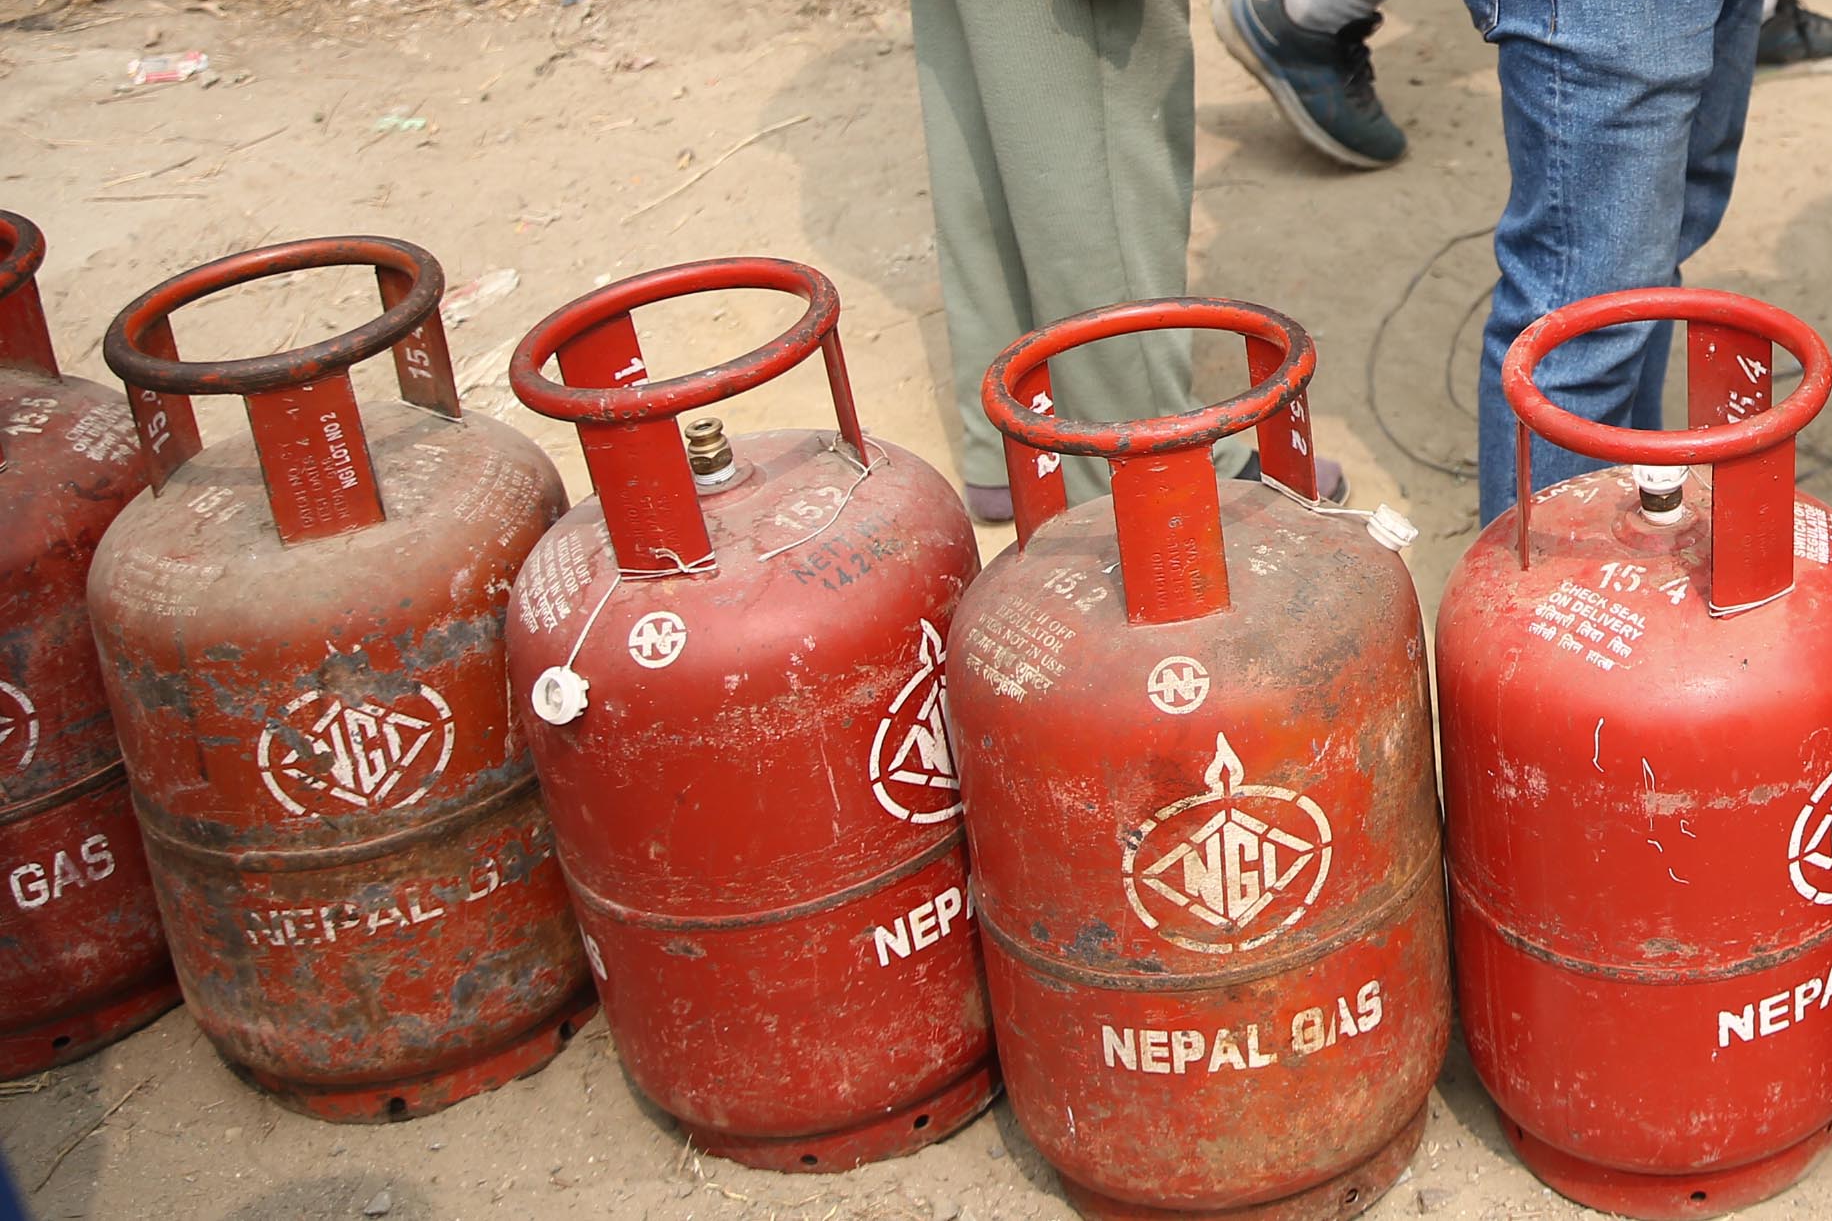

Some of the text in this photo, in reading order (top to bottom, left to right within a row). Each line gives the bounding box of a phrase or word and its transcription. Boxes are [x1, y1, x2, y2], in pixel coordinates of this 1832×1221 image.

[320, 411, 359, 490] NGI LOT NO 2
[996, 604, 1064, 654] REGULATOR
[1549, 591, 1645, 642] ON DELIVERY
[1559, 579, 1648, 630] CHECK SEAL
[1002, 629, 1029, 650] NOT
[1040, 654, 1066, 677] USE
[1048, 620, 1077, 641] OFF
[10, 833, 117, 912] GAS
[1182, 821, 1279, 922] NGI
[1100, 1023, 1279, 1076] NEPAL
